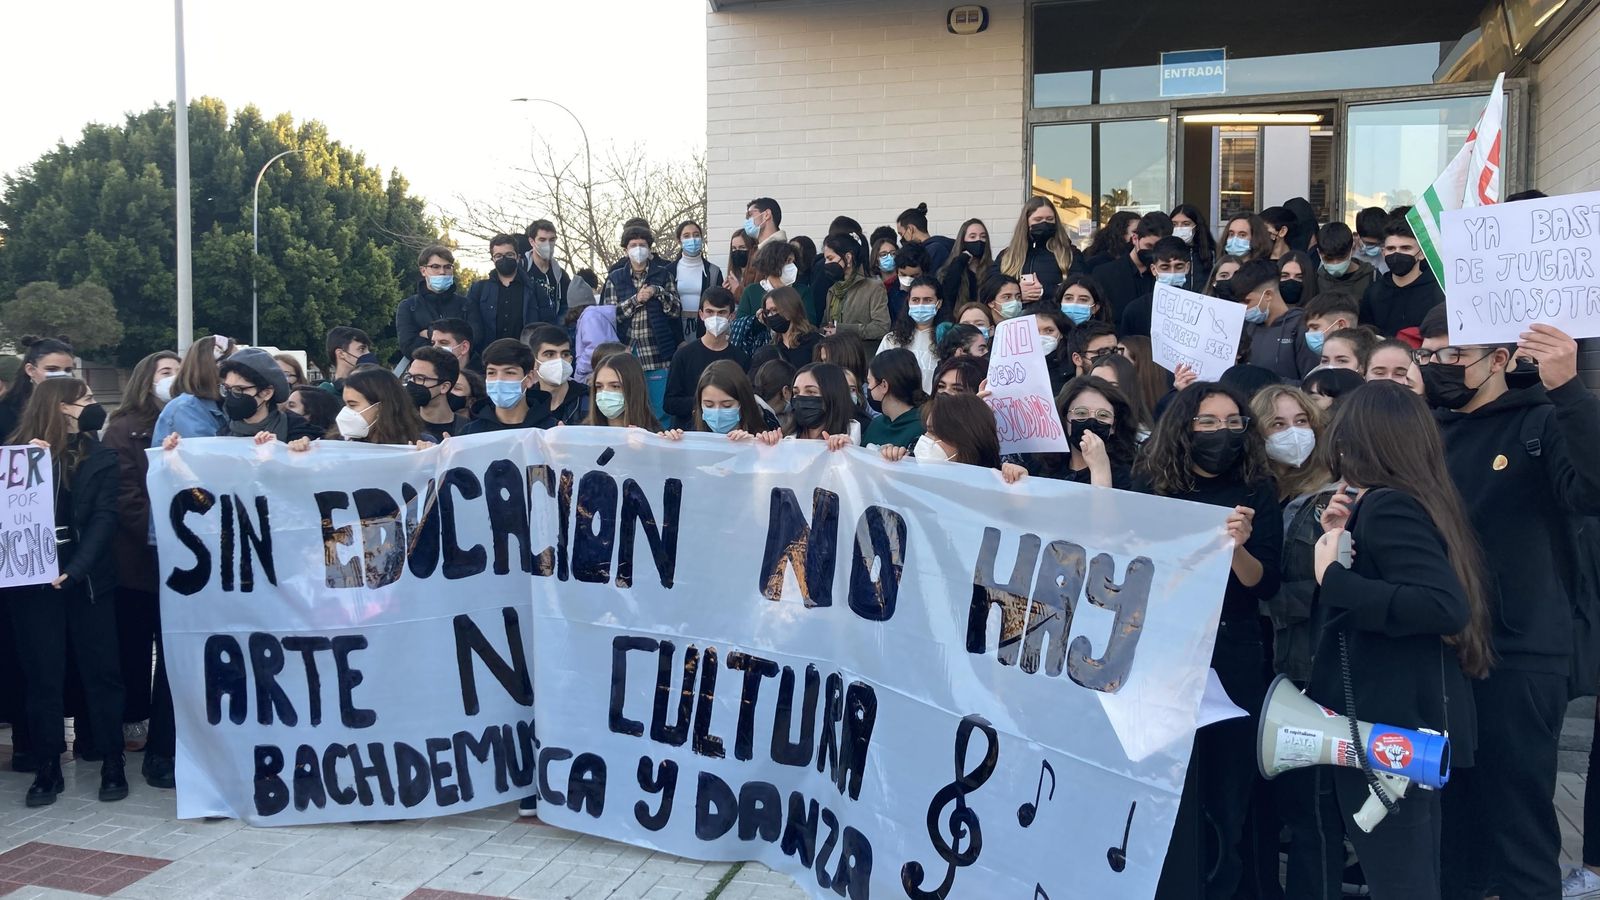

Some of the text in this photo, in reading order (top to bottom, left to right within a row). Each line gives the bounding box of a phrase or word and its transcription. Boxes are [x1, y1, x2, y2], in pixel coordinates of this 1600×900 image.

[1164, 65, 1223, 79] ENTRADA
[1464, 216, 1500, 250] YA
[1455, 247, 1594, 285] DE JUGAR
[1001, 320, 1033, 357] NO
[1204, 338, 1233, 361] SER
[8, 492, 39, 508] POR
[13, 512, 32, 526] UN
[166, 446, 1154, 694] SIN EDUCACIÓN NO HAY
[203, 631, 377, 728] ARTE
[608, 634, 878, 802] CULTURA
[633, 754, 679, 832] Y
[694, 770, 873, 900] DANZA
